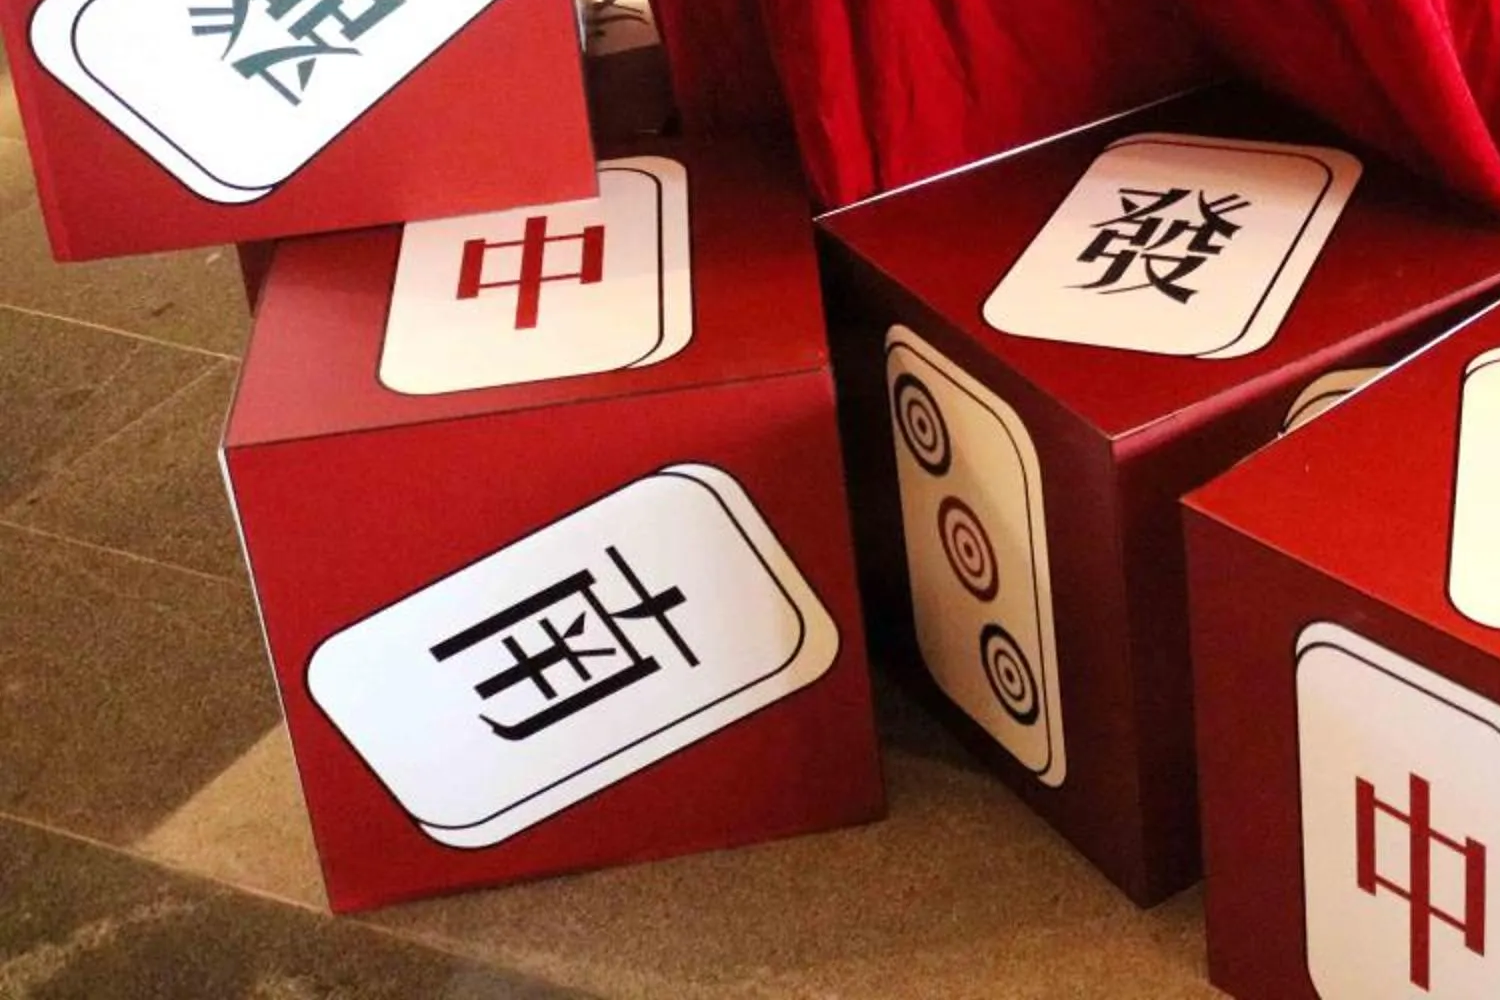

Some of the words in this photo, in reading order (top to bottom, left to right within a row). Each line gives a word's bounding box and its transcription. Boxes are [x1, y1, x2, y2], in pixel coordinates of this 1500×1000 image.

[457, 216, 604, 329] 中
[1064, 187, 1252, 304] 發
[429, 546, 700, 741] 南
[1355, 772, 1485, 992] 中
